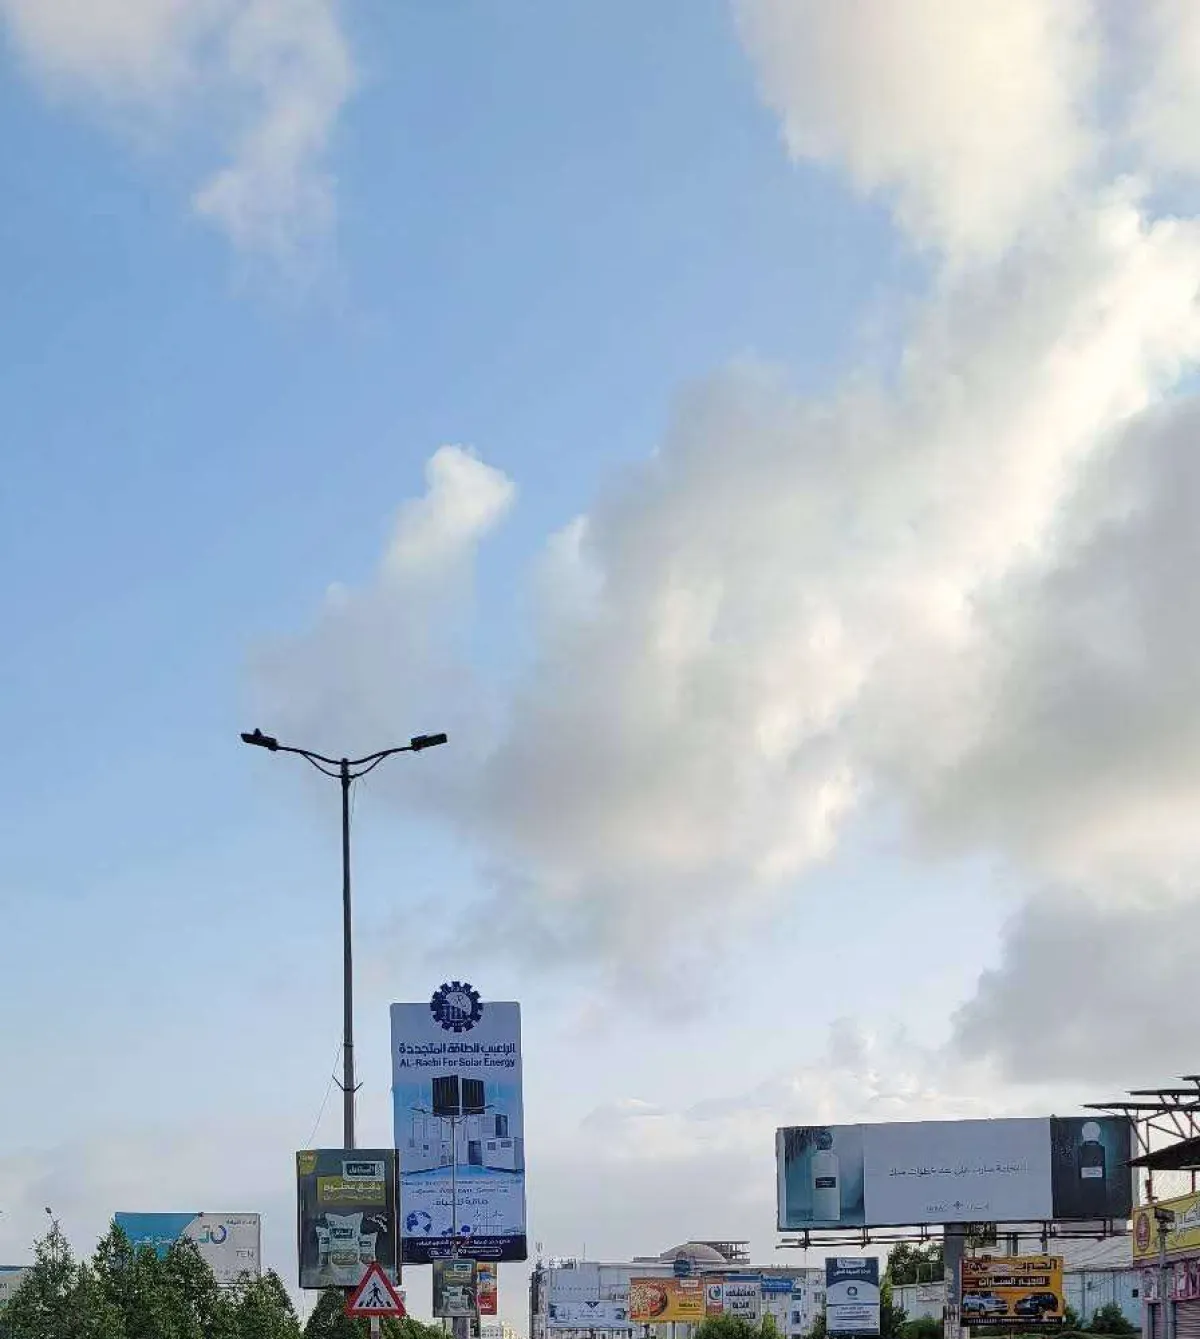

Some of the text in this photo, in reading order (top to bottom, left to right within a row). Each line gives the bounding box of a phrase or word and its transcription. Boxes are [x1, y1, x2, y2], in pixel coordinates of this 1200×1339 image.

[398, 1042, 446, 1057] المتجددة
[447, 1042, 479, 1054] للطاقة
[443, 1058, 458, 1067] For
[459, 1058, 482, 1067] Solar
[484, 1058, 516, 1068] Energy
